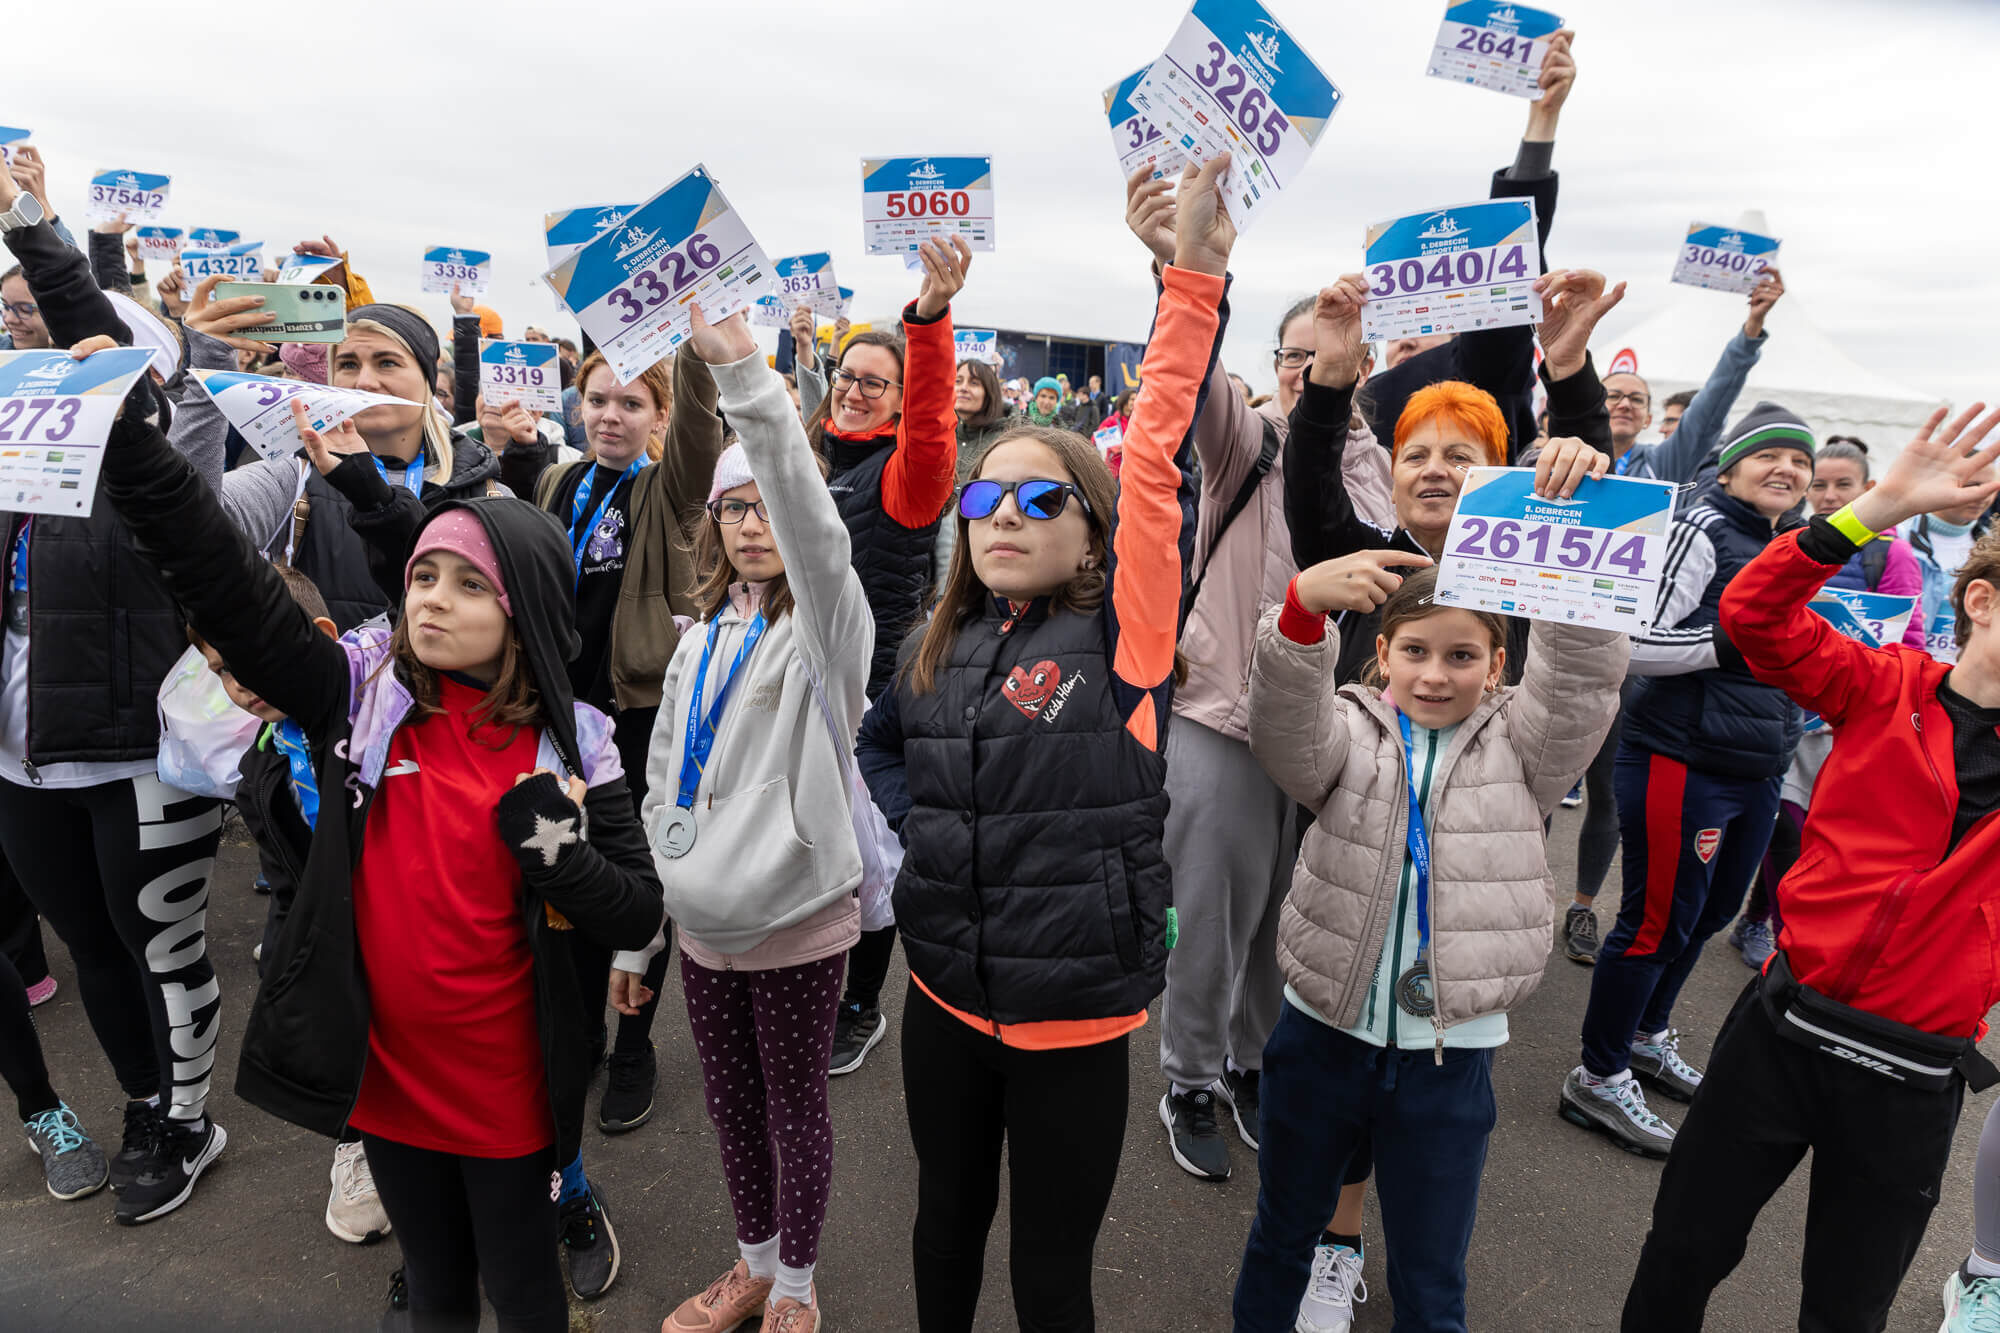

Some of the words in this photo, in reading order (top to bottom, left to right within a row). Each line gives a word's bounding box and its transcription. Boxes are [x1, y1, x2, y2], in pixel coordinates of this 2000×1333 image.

[1456, 27, 1533, 64] 2641
[1195, 41, 1289, 157] 3265
[93, 186, 163, 208] 3754/2
[886, 191, 970, 218] 5060
[144, 238, 177, 249] 5049
[630, 237, 667, 266] DEBRECEN
[1429, 236, 1469, 249] DEBRECEN
[184, 257, 259, 279] 1432/2
[434, 263, 478, 281] 3336
[607, 233, 721, 324] 3326
[1371, 244, 1528, 297] 3040/4
[782, 274, 821, 294] 3631
[956, 343, 986, 353] 3740
[492, 365, 544, 386] 3319
[1523, 513, 1561, 524] AIRPORT
[1562, 517, 1581, 526] RUN
[1535, 506, 1582, 518] DEBRECEN
[1454, 518, 1647, 576] 2615/4
[1831, 1046, 1894, 1072] DHL
